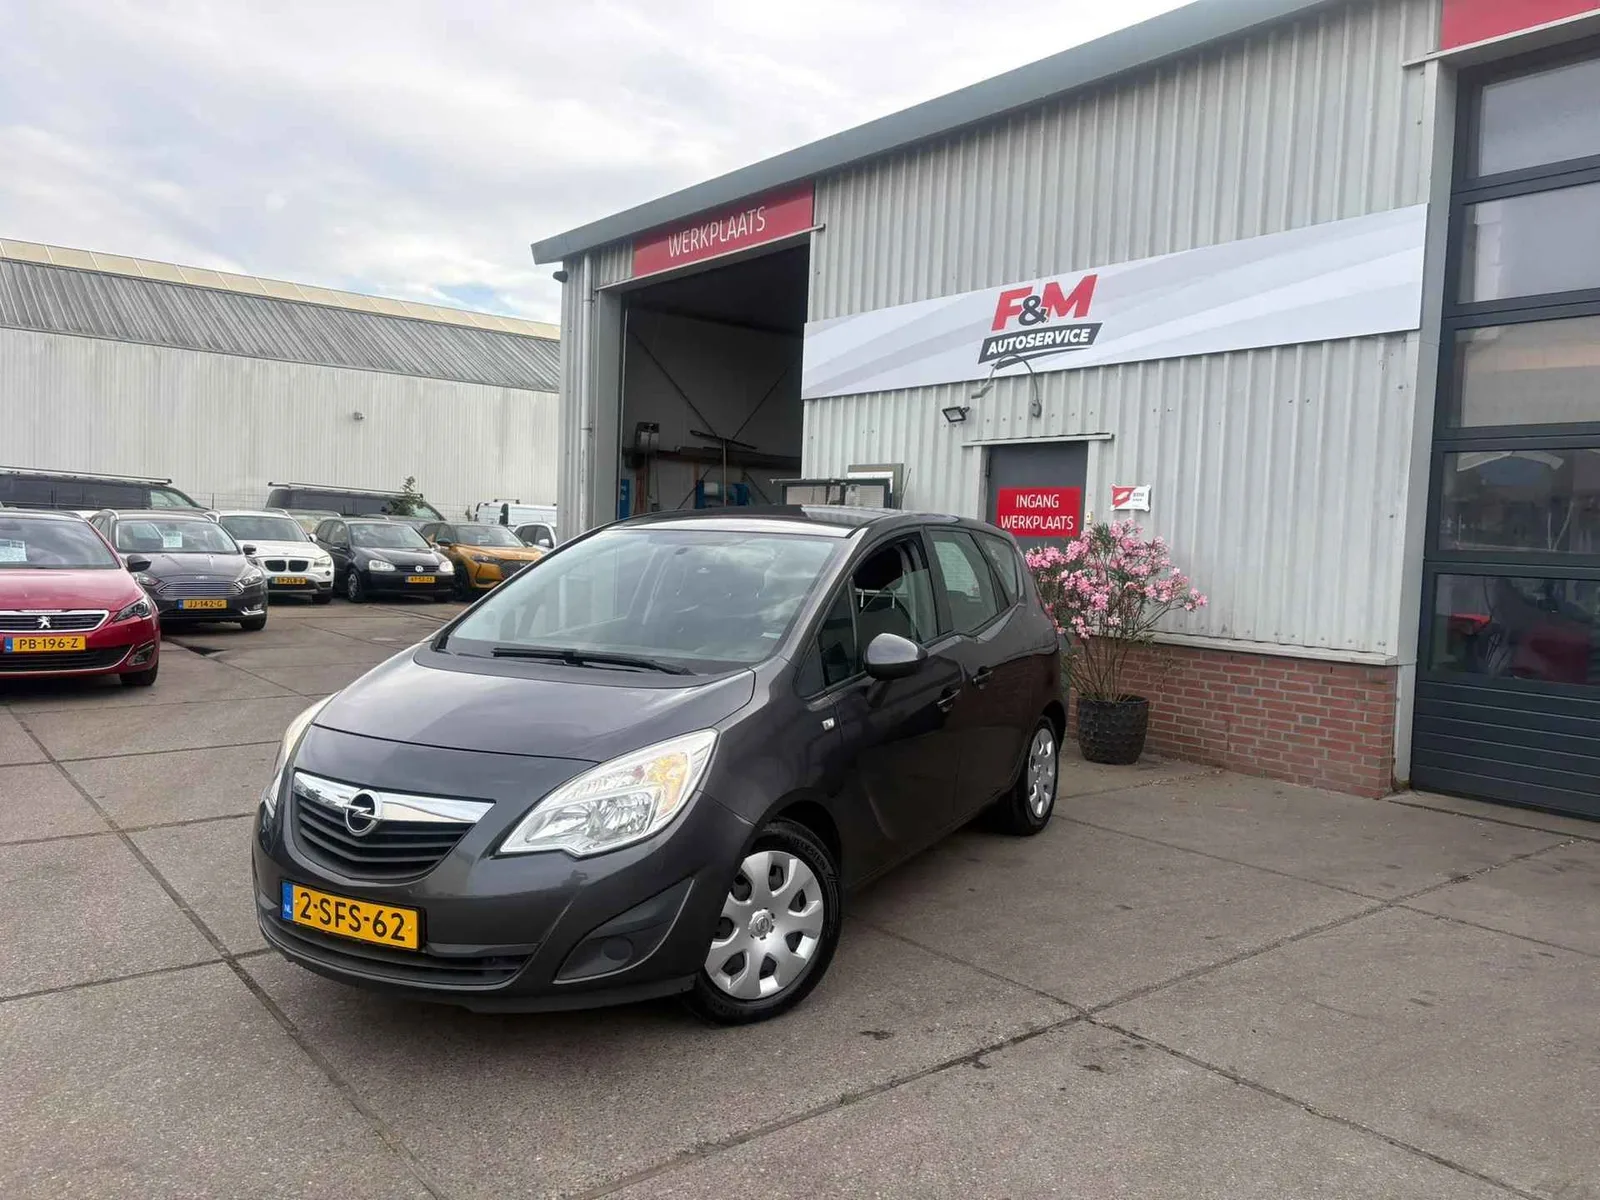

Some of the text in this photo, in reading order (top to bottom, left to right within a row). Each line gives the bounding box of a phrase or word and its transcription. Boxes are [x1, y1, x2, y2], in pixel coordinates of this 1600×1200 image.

[667, 206, 767, 258] WERKPLAATS
[991, 274, 1098, 331] F&M
[986, 328, 1091, 355] AUTOSERVICE
[1015, 494, 1060, 509] INGANG
[1000, 515, 1074, 530] WERKPLAATS
[187, 600, 223, 608] JJ-142-G
[19, 638, 79, 649] PB-196-Z
[300, 891, 406, 942] 2-SFS-62
